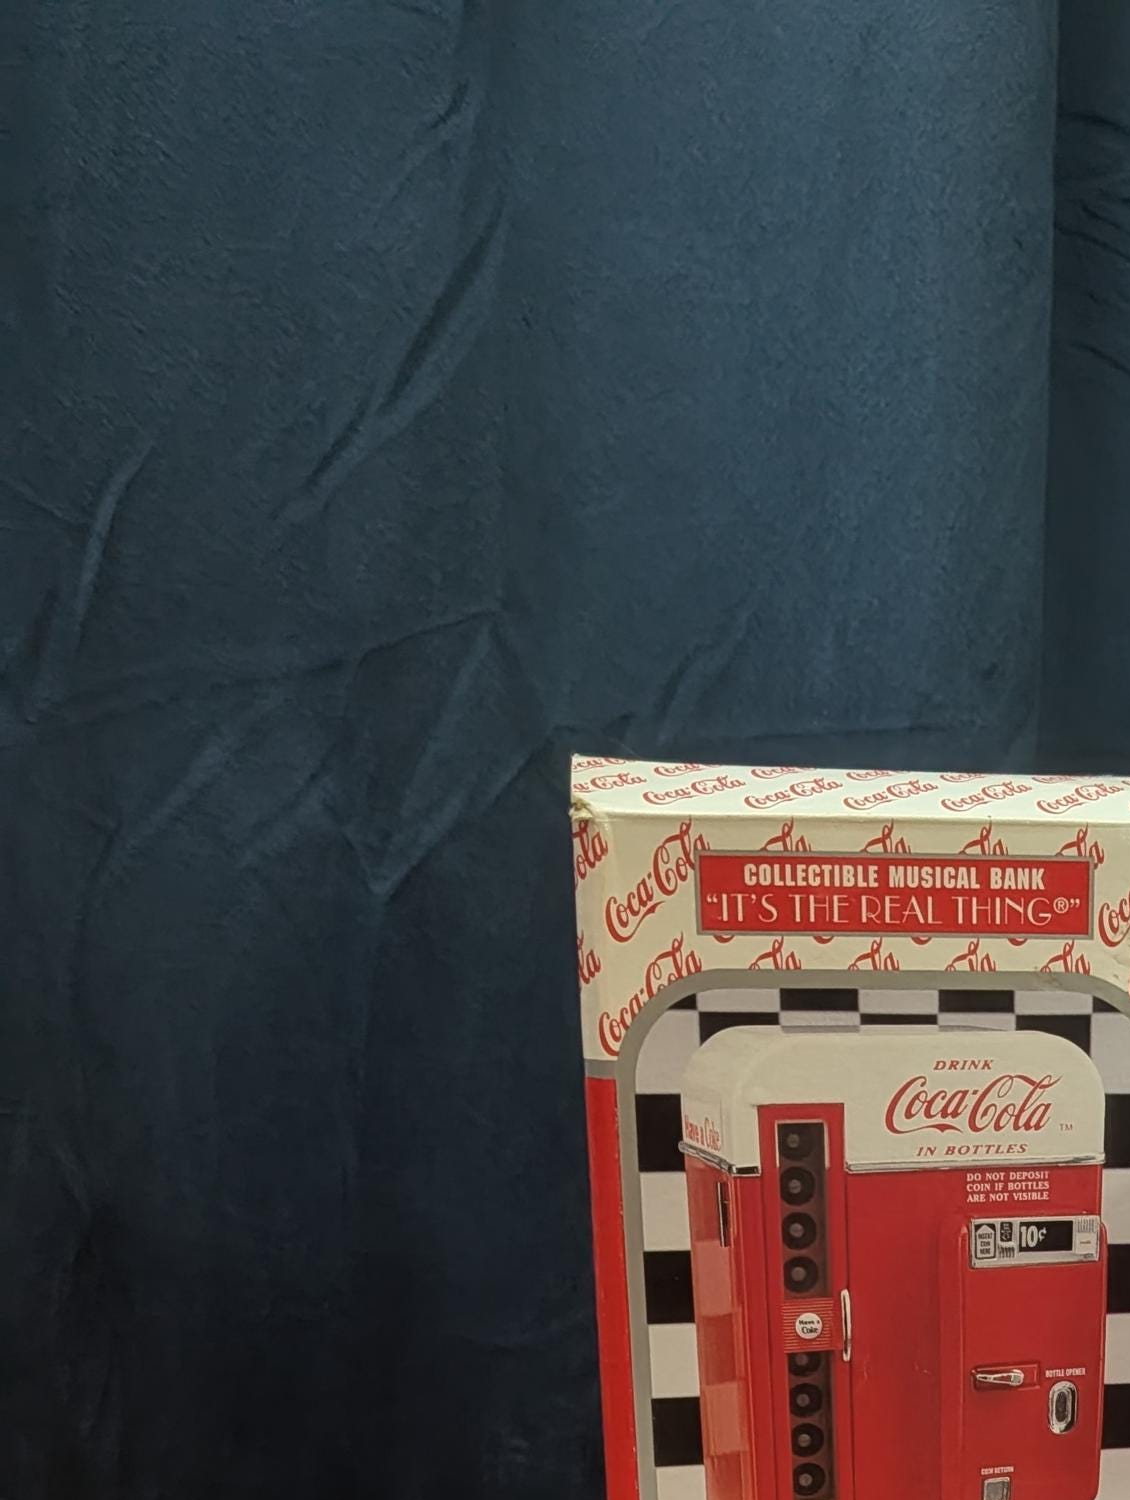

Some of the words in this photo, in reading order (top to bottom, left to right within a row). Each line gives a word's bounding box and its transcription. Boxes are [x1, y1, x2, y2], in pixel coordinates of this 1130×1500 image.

[643, 775, 746, 805] Coca-Cola
[745, 776, 842, 809] Coca-Cola
[843, 779, 938, 810] Coca-Cola
[940, 781, 1032, 812] Coca-Cola
[1037, 784, 1124, 814] Coca-Cola
[744, 863, 878, 887] COLLECTIBLE
[889, 866, 980, 889] MUSICAL
[990, 868, 1045, 889] BANK
[789, 894, 849, 923] THE
[861, 896, 943, 925] REAL
[933, 1060, 994, 1070] DRINK
[885, 1074, 1064, 1134] Coca-Cola
[917, 1146, 936, 1156] IN
[945, 1144, 1028, 1155] BOTTLES
[967, 1173, 981, 1181] DO
[1010, 1171, 1049, 1179] DEPOSIT
[967, 1183, 990, 1191] COIN
[995, 1183, 1005, 1191] IF
[1008, 1182, 1049, 1190] BOTTLES
[967, 1194, 986, 1202] ARE
[990, 1193, 1009, 1201] NOT
[1013, 1192, 1049, 1200] VISIBLE
[1021, 1225, 1046, 1247] 10¢
[801, 1326, 818, 1334] Coke
[1046, 1369, 1064, 1377] BOTTLE
[1066, 1368, 1085, 1376] OPENER
